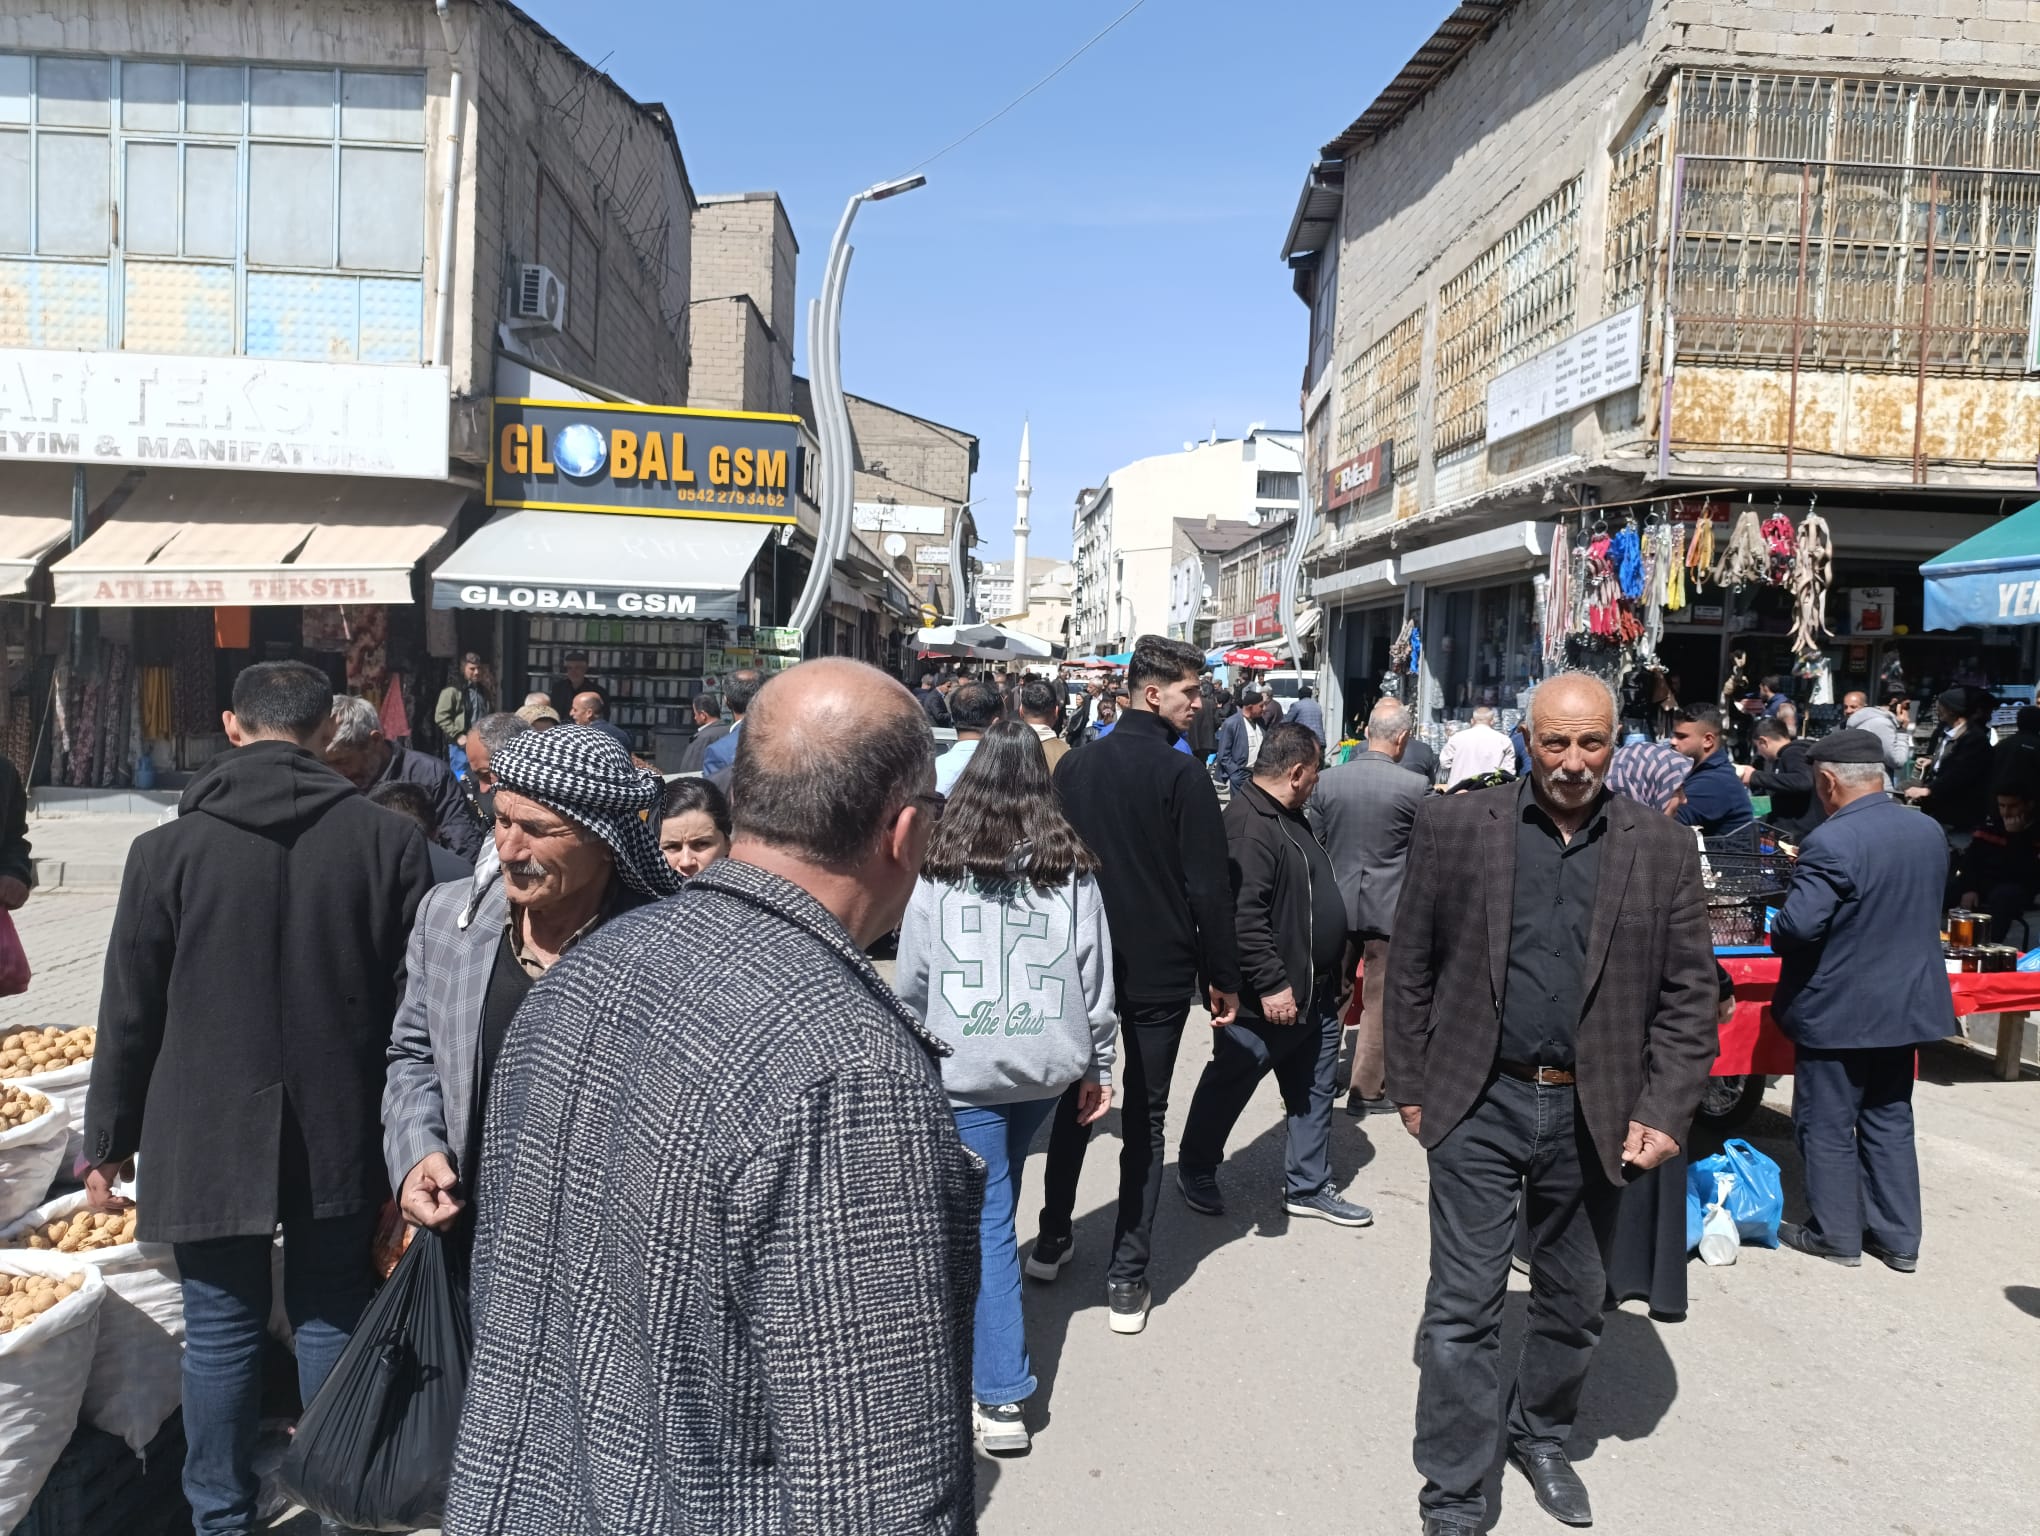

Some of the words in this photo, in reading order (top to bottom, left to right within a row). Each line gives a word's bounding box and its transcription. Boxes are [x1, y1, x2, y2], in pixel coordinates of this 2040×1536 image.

[95, 434, 122, 456] &
[708, 445, 786, 488] GSM
[678, 487, 715, 502] 0542
[717, 491, 745, 504] 279
[747, 493, 785, 507] 3462
[95, 580, 225, 600] ATLILAR
[460, 586, 606, 610] GLOBAL
[617, 592, 697, 614] GSM
[941, 884, 1073, 1019] 92
[962, 999, 1001, 1037] The
[1003, 1001, 1046, 1037] Club
